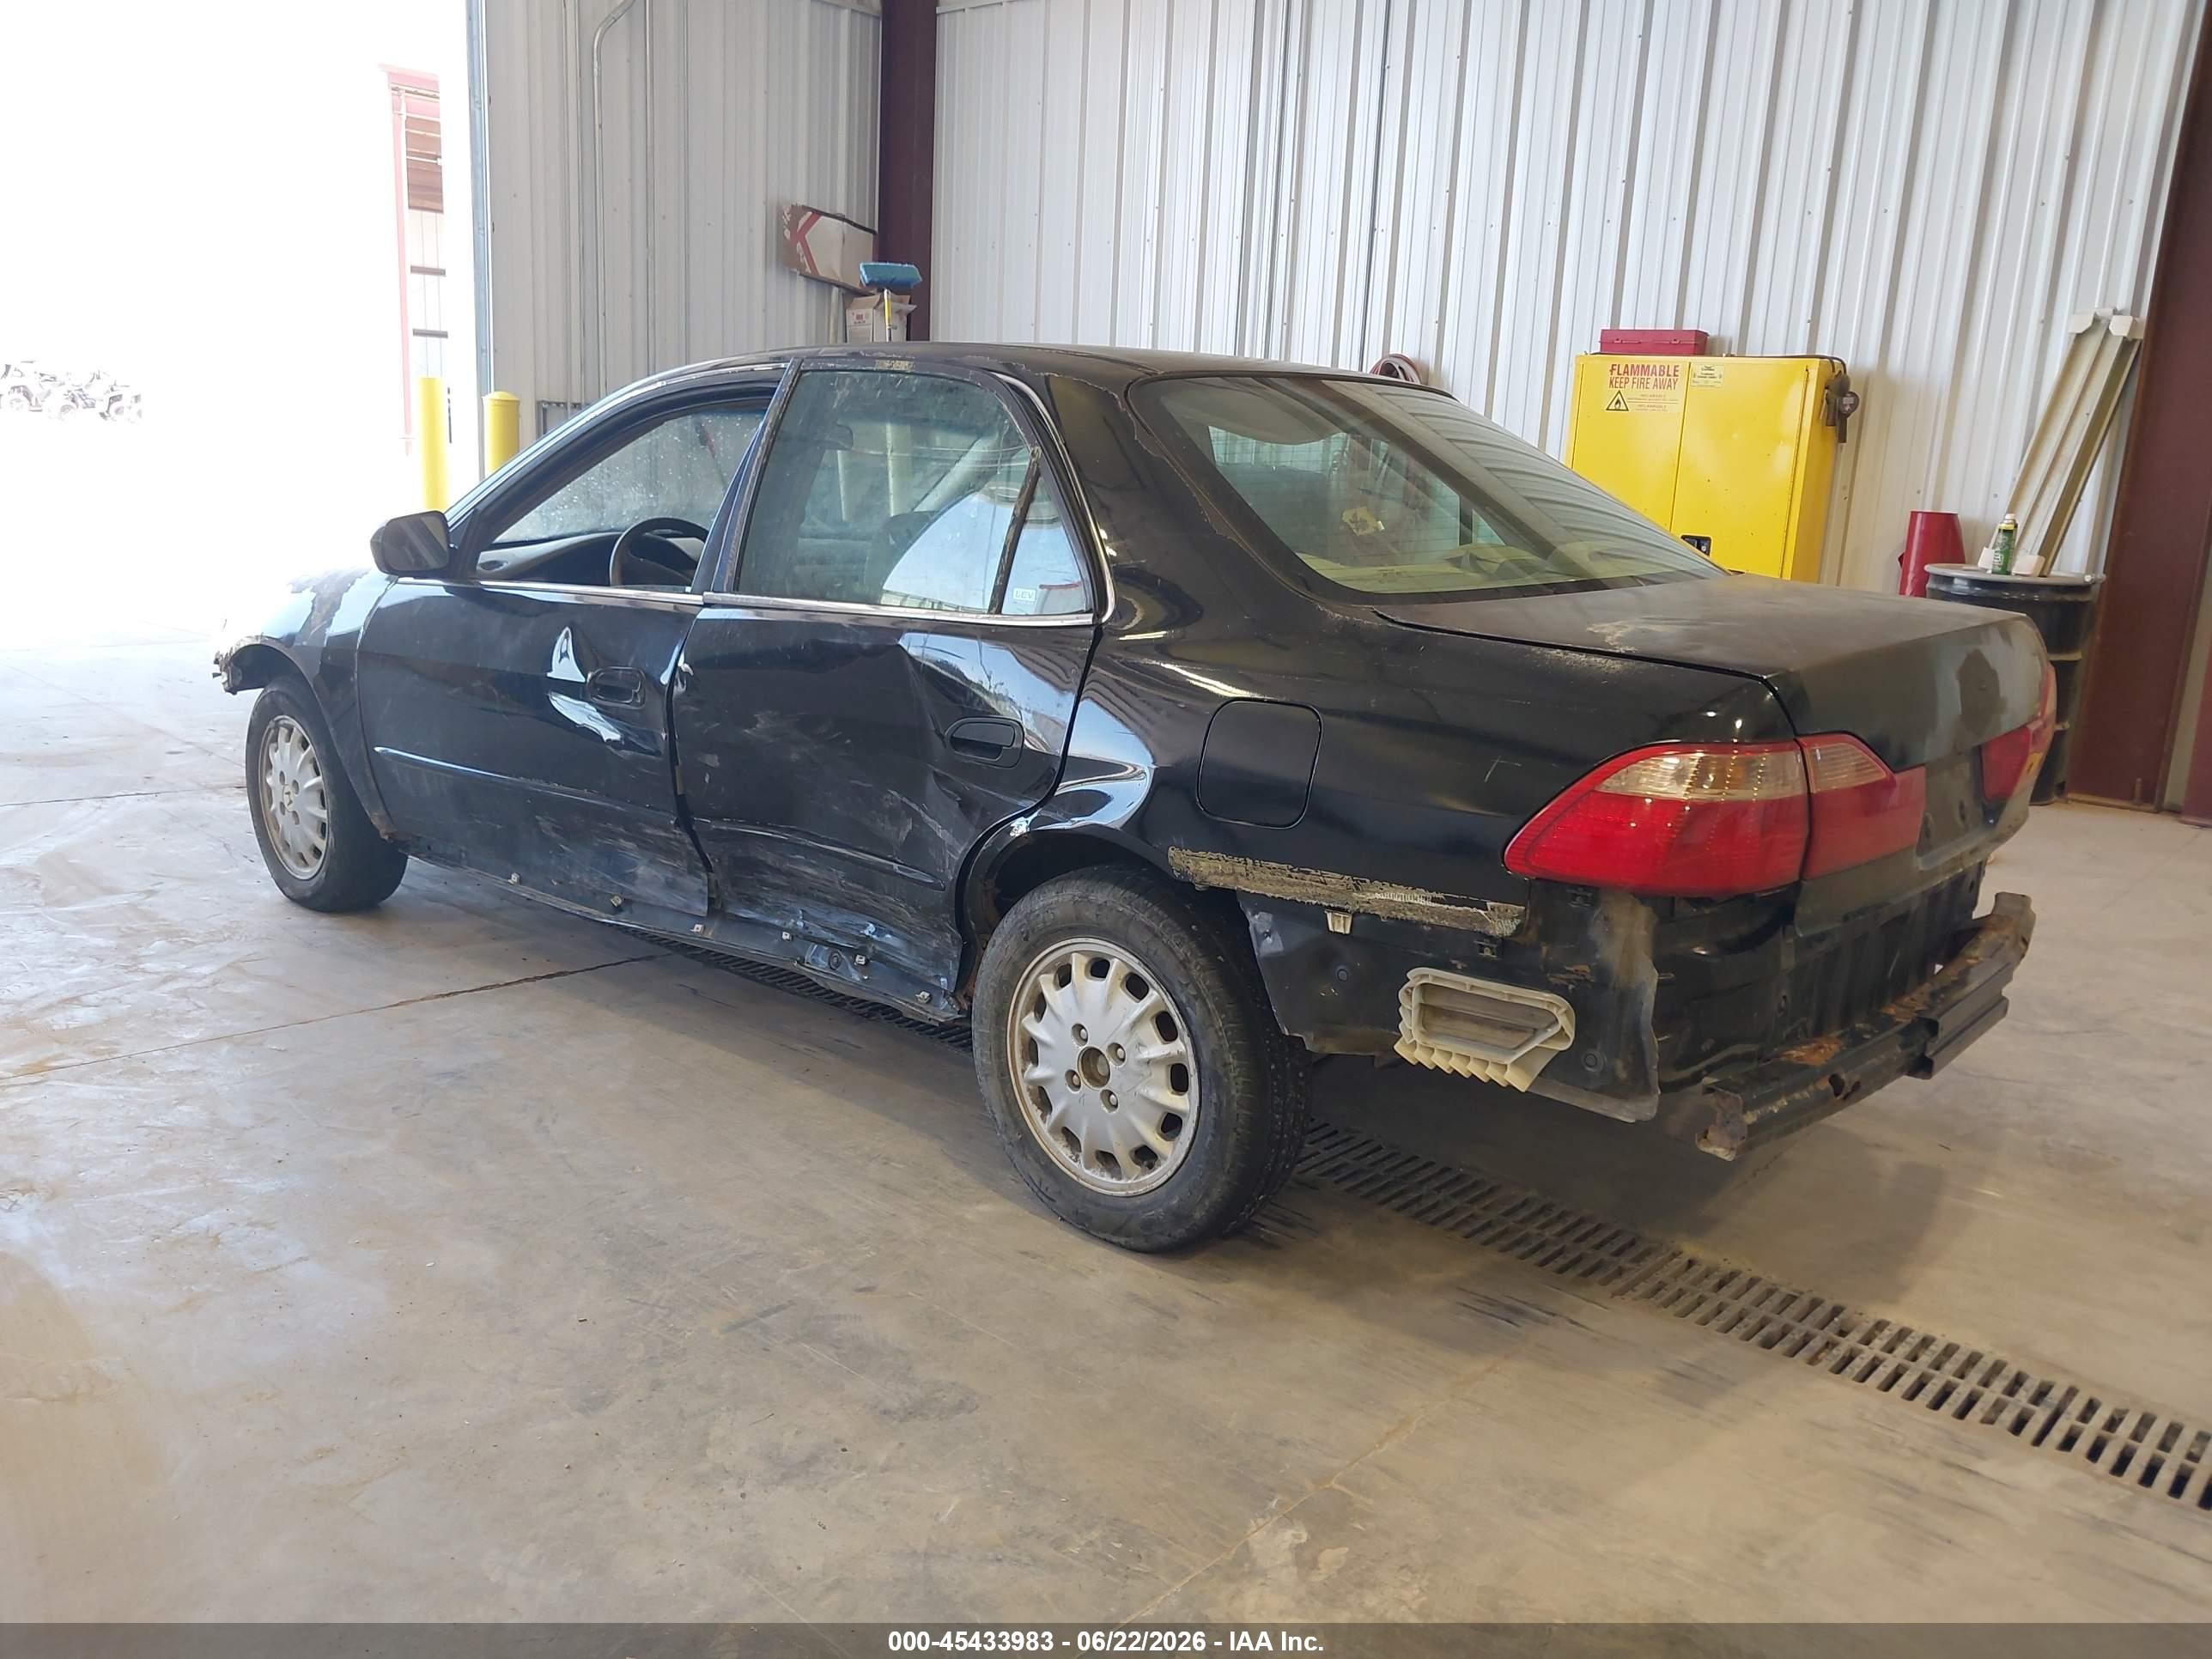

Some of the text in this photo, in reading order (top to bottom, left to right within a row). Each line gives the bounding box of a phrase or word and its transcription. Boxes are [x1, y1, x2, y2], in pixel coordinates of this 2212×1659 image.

[1609, 363, 1680, 378] FLAMMABLE
[1608, 376, 1679, 391] KEEP FIRE AWAY
